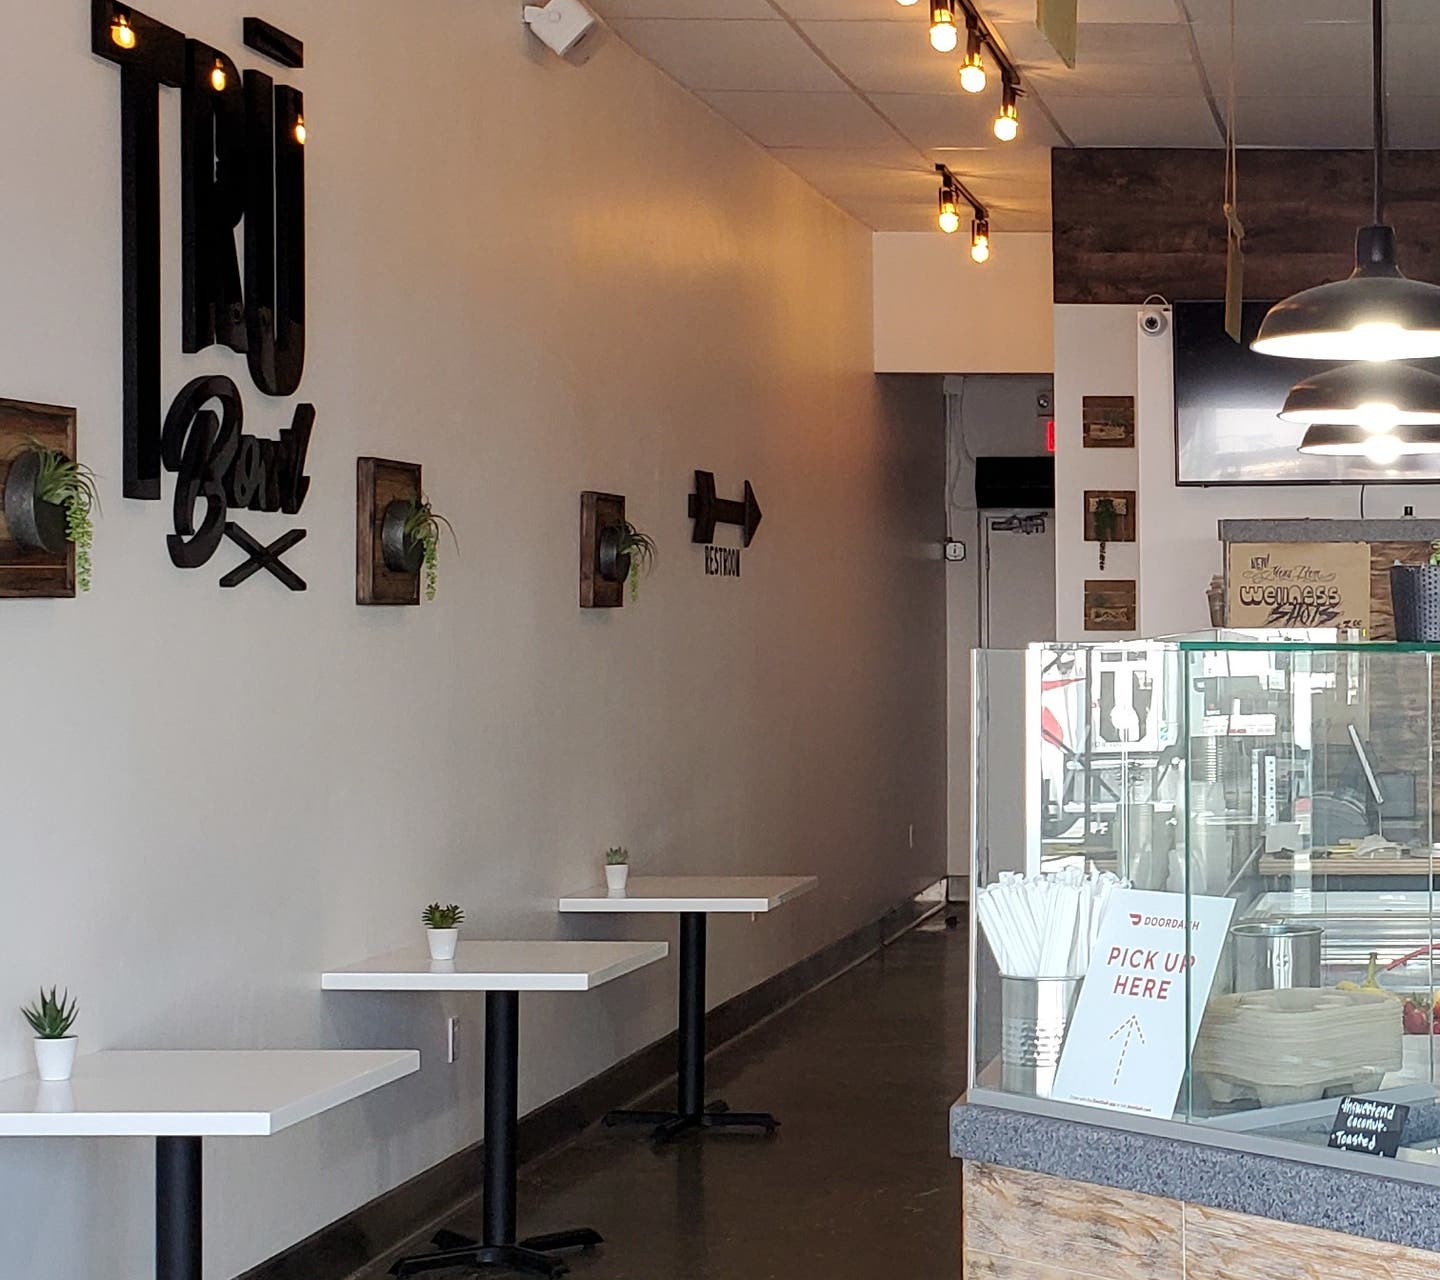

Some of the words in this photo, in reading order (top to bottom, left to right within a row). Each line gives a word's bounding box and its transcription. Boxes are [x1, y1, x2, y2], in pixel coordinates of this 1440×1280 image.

[1144, 916, 1200, 930] DOORDAH
[1107, 946, 1159, 970] PICK
[1164, 952, 1196, 974] UP
[1113, 974, 1172, 1000] HERE
[1336, 1130, 1376, 1151] Toasted
